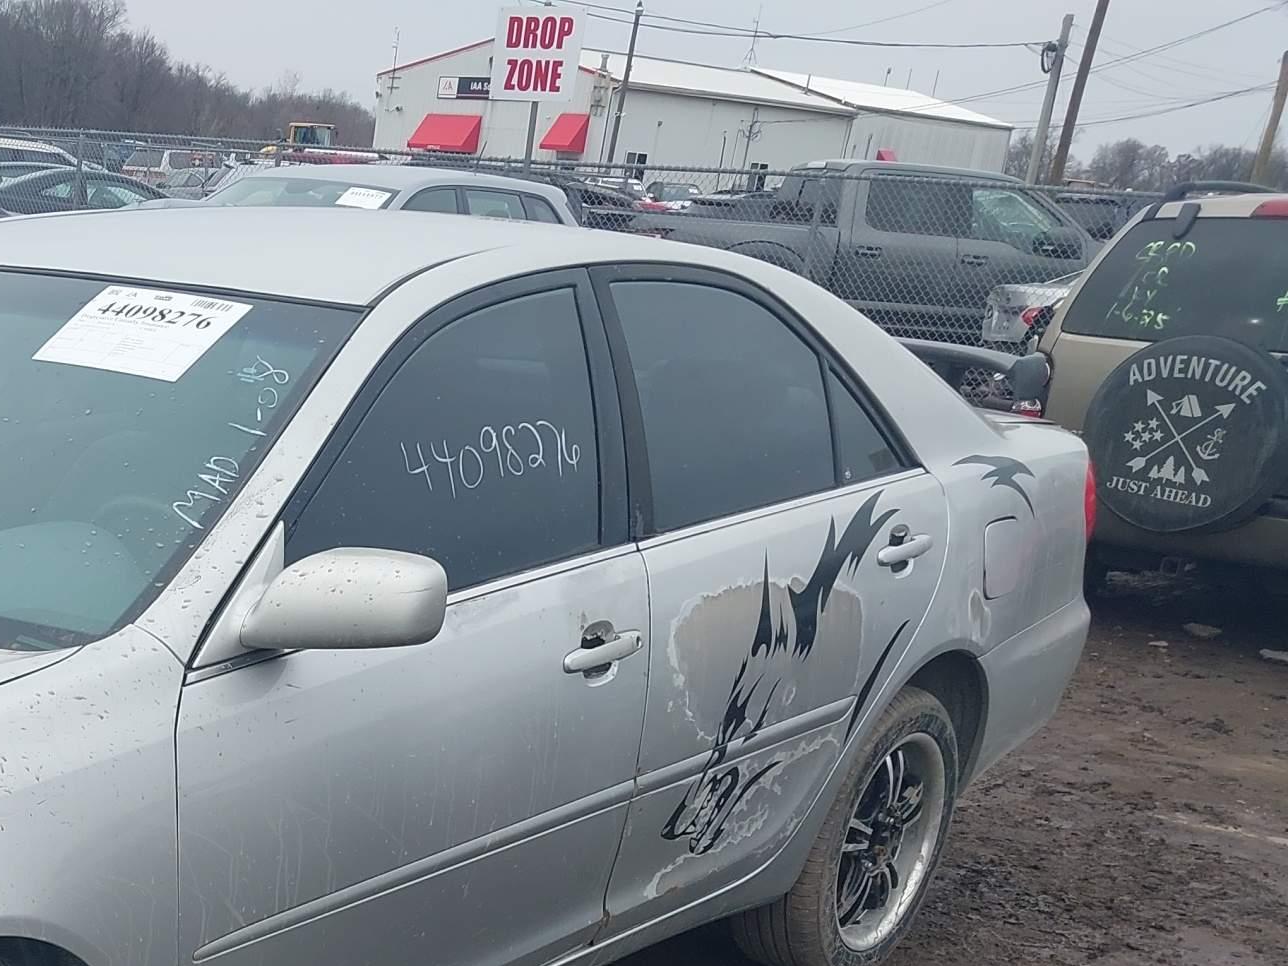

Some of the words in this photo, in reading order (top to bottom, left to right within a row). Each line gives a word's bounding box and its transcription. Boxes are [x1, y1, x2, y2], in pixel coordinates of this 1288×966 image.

[506, 16, 574, 49] DROP
[470, 81, 482, 91] IAA
[503, 59, 564, 92] ZONE
[97, 301, 217, 330] 44098276
[1128, 355, 1267, 404] ADVENTURE
[400, 420, 580, 499] 44098276
[172, 456, 240, 529] MAD
[1106, 476, 1149, 495] JUST
[1150, 485, 1212, 508] AHEAD
